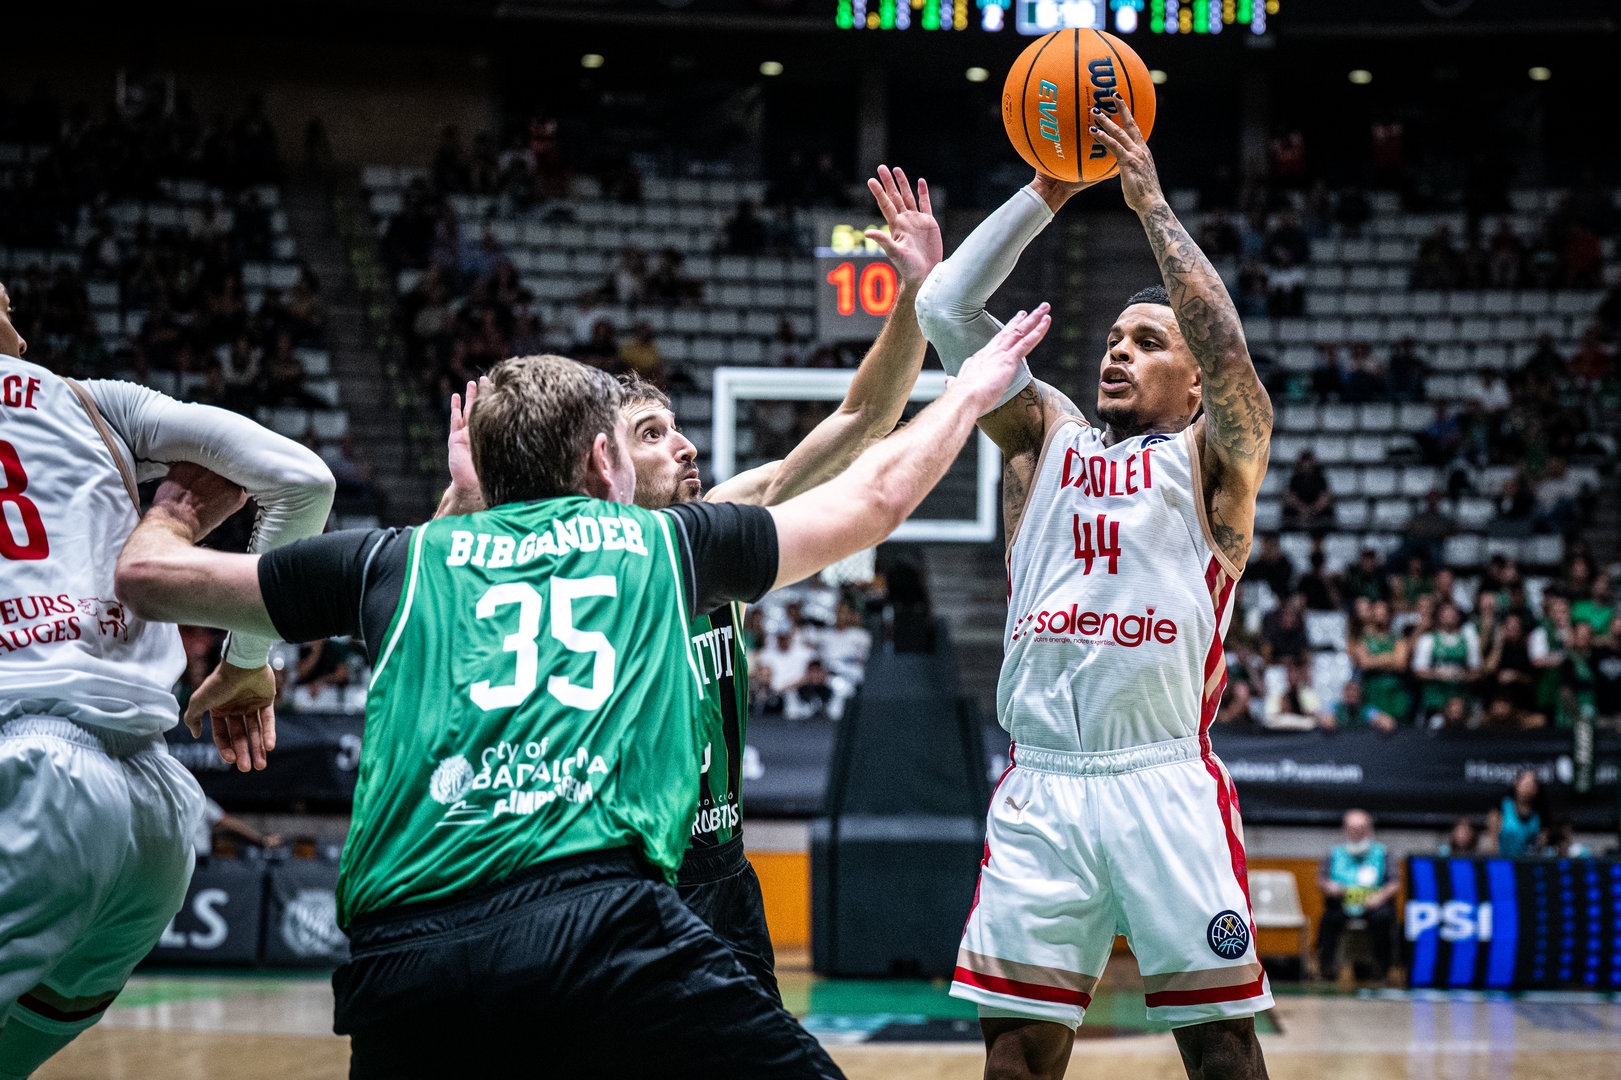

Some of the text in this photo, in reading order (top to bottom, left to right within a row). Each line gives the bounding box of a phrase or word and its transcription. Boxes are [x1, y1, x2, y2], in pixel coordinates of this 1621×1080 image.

[1038, 79, 1065, 159] EVO NXT
[1088, 56, 1118, 160] Wiln
[827, 262, 898, 316] 10
[0, 375, 41, 410] CE
[1073, 514, 1122, 575] 44
[0, 594, 75, 625] EURS
[1034, 604, 1177, 647] solengie
[469, 575, 618, 711] 35
[481, 737, 550, 768] Cty of
[1404, 899, 1494, 942] PSI
